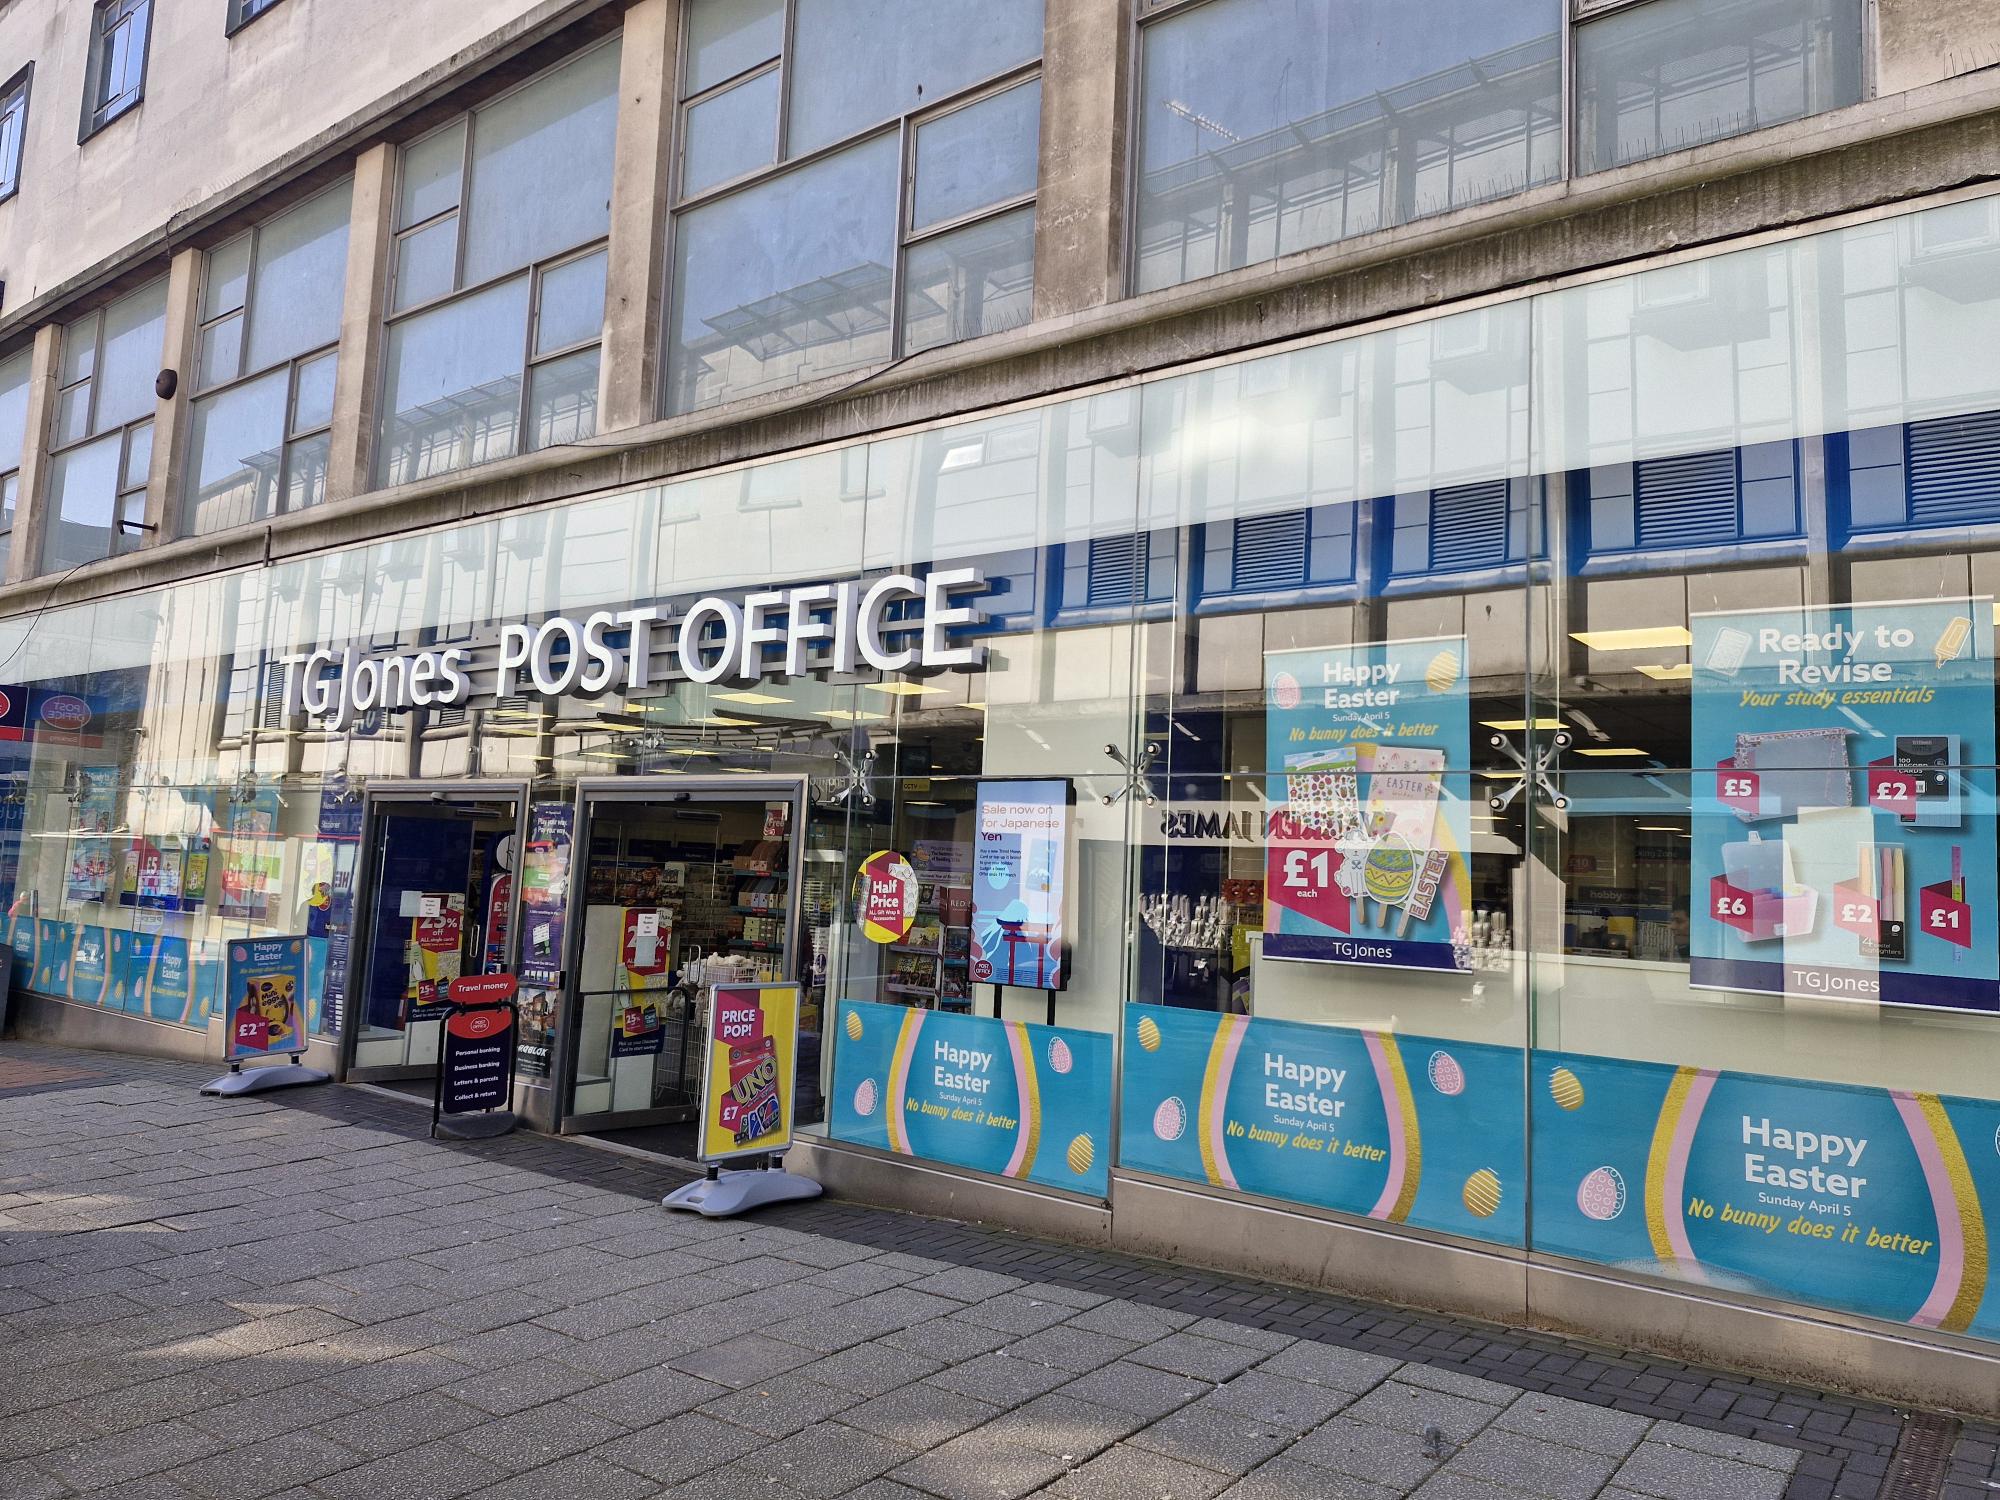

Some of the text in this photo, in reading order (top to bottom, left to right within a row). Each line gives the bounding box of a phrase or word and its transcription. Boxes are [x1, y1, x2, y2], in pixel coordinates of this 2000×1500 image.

[1759, 624, 1915, 656] Ready to
[279, 567, 985, 732] TGJones POST OFFICE
[1323, 662, 1401, 687] Happy
[1779, 658, 1893, 685] Revise
[1324, 688, 1400, 709] Easter
[1739, 686, 1936, 709] Your study essentials
[1333, 711, 1390, 722] Sunday April 5
[1289, 722, 1439, 743] No bunny does it better
[1386, 778, 1423, 793] EASTER
[1724, 779, 1753, 797] £5
[1876, 782, 1908, 801] £2
[982, 804, 1053, 815] Sale now on
[981, 818, 1060, 831] for Japanese
[980, 831, 1002, 841] Yen
[1282, 849, 1329, 888] £1
[872, 880, 898, 895] Half
[1408, 849, 1450, 918] EASTER
[870, 895, 899, 908] Price
[1297, 889, 1318, 898] each
[1717, 897, 1747, 915] £6
[1841, 904, 1873, 923] £2
[1930, 909, 1959, 929] £1
[253, 943, 283, 953] Happy
[253, 952, 283, 962] Easter
[1333, 942, 1393, 959] TGJones
[162, 953, 182, 968] Happy
[162, 966, 181, 980] Easter
[975, 967, 991, 975] OFFICE
[457, 982, 508, 993] Travel money
[1792, 971, 1880, 993] TGJones
[721, 1009, 756, 1024] PRICE
[723, 1024, 753, 1038] POP!
[455, 1046, 501, 1057] Personal banking
[517, 1044, 548, 1057] ROBLOX
[934, 1040, 992, 1073] Happy
[454, 1061, 500, 1072] Business banking
[1264, 1052, 1347, 1093] Happy
[453, 1079, 473, 1087] Letters
[479, 1075, 499, 1083] parcels
[731, 1055, 777, 1105] UNO
[934, 1065, 991, 1094] Easter
[454, 1093, 474, 1101] Collect
[480, 1090, 497, 1098] return
[939, 1091, 962, 1104] Sunday
[962, 1096, 977, 1106] April
[1264, 1083, 1345, 1118] Easter
[723, 1106, 739, 1121] £7
[905, 1097, 1017, 1130] No bunny does it better
[1273, 1114, 1335, 1133] Sunday April 5
[1226, 1119, 1387, 1163] No bunny does it better
[1741, 1115, 1868, 1167] Happy
[1745, 1153, 1867, 1199] Easter
[1758, 1191, 1852, 1217] Sunday April 5
[1687, 1197, 1933, 1256] No bunny does it better
